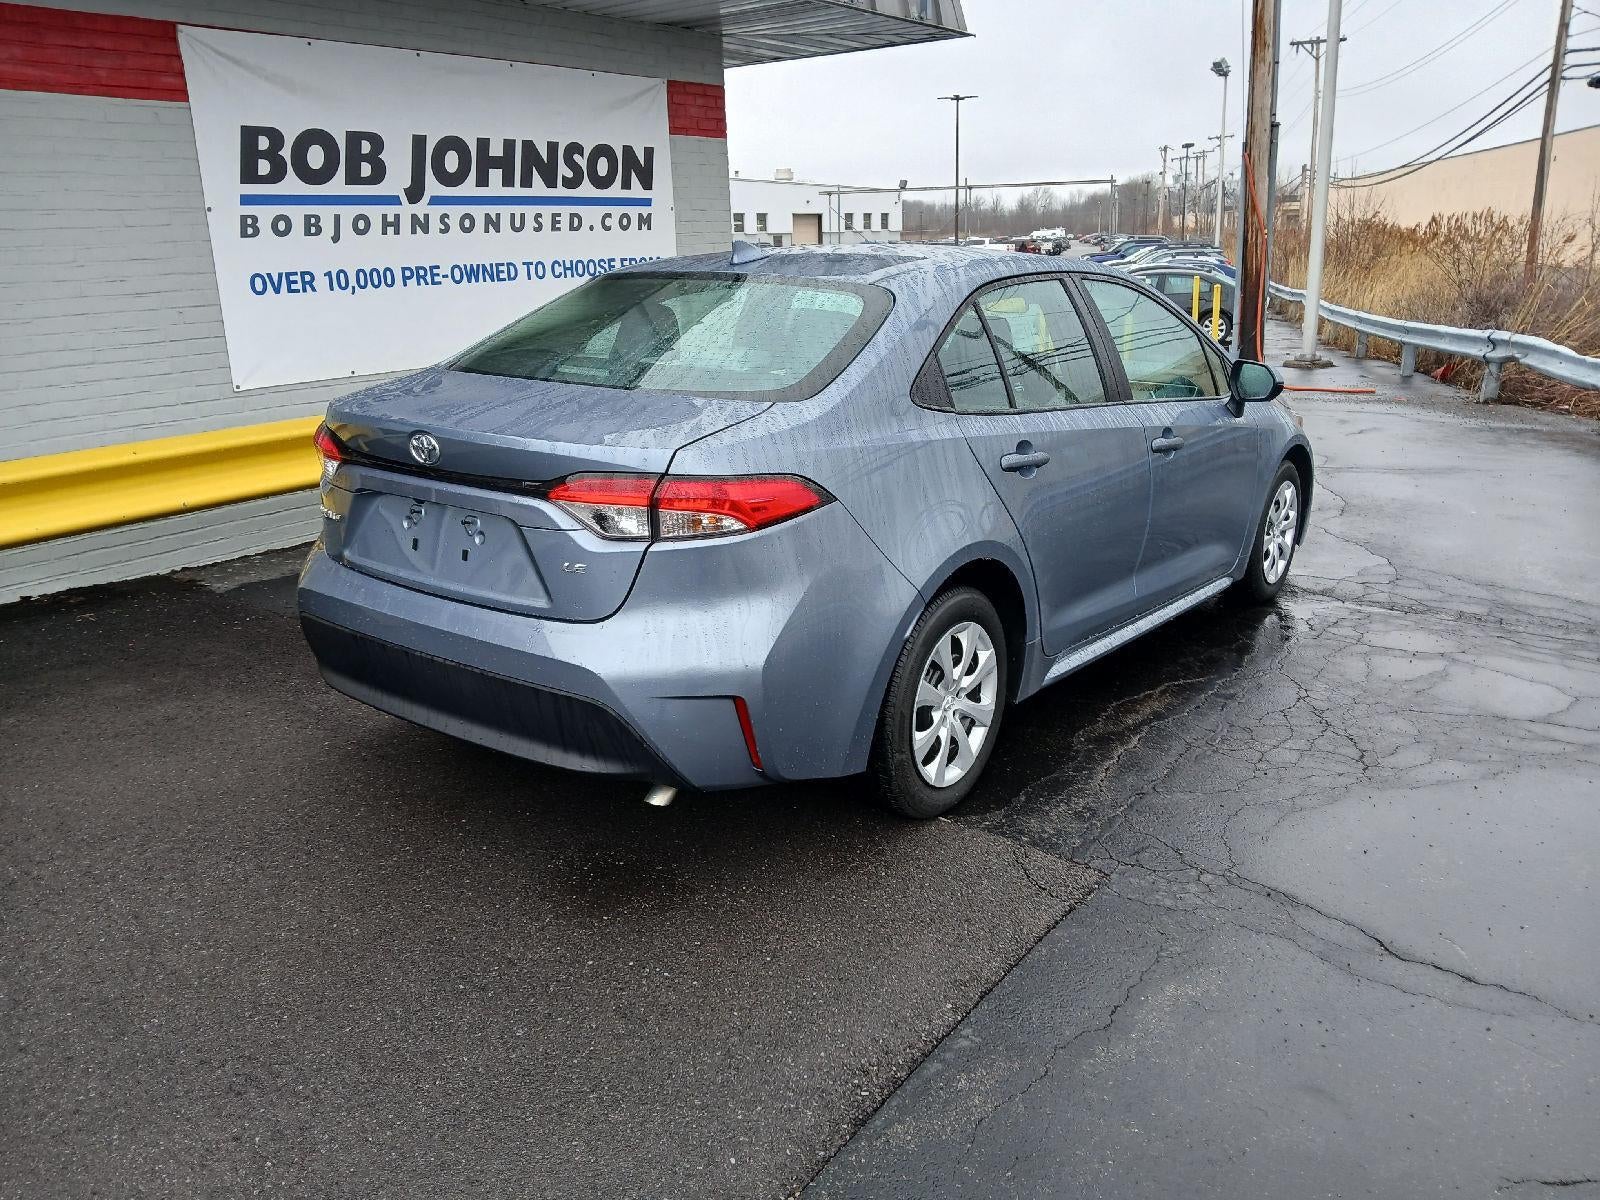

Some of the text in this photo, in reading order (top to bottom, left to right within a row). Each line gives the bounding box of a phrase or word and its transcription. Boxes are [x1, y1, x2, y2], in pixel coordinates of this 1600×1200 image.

[240, 125, 655, 205] BOB JOHNSON
[240, 212, 653, 244] BOBJOHNSONUSED.COM
[249, 270, 317, 296] OVER
[324, 266, 396, 295] 10,000
[401, 261, 519, 288] PRE-OWNED
[522, 260, 547, 281] TO
[550, 257, 616, 279] CHOOSE
